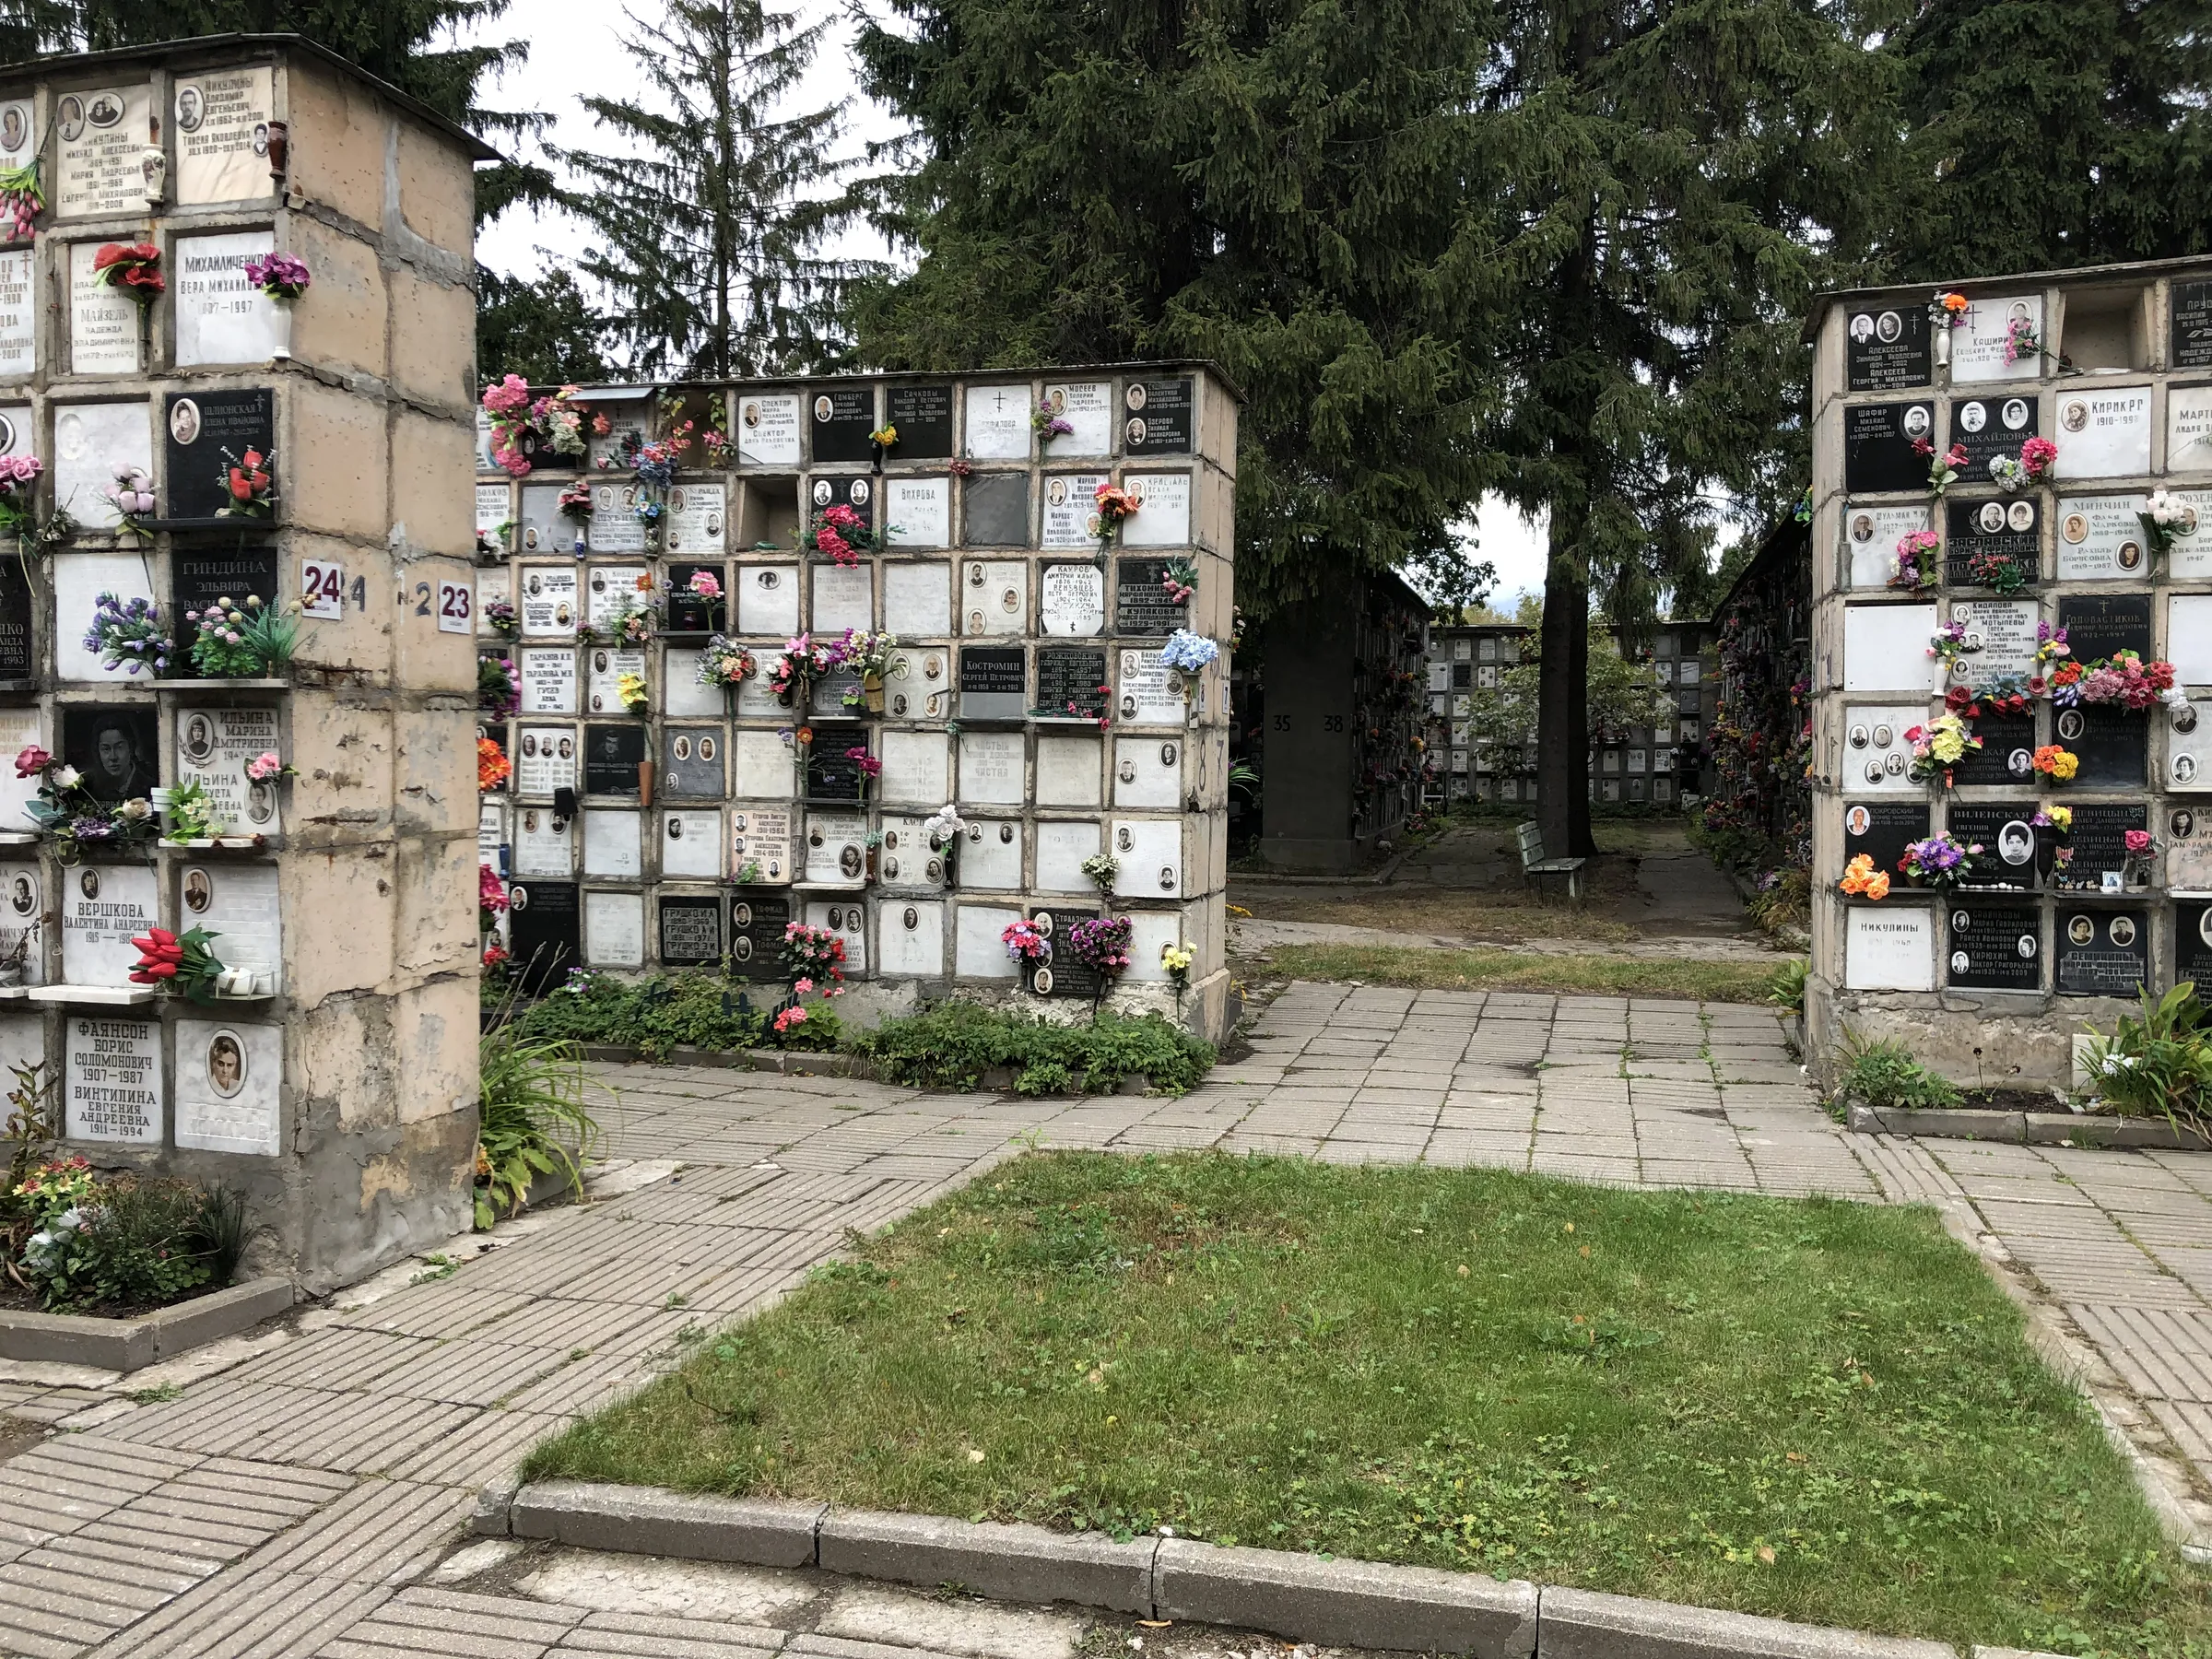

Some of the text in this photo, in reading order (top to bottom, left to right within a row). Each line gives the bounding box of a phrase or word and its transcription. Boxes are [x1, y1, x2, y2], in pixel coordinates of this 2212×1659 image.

[181, 280, 203, 294] ВЕРА
[81, 308, 128, 323] МАЙЗЕЛЬ
[1869, 345, 1908, 354] АЛЕКСЕЕВА
[1870, 368, 1906, 377] АЛЕКСЕЕВ
[1858, 409, 1888, 418] ШАФИР
[2176, 424, 2201, 433] ЛИДИЯ
[2074, 501, 2130, 511] МИНЧИН
[182, 560, 267, 575] ГИНДИНА
[196, 582, 252, 593] ЭЛЬВИРА
[304, 566, 339, 609] 24
[441, 586, 469, 618] 23
[968, 661, 1020, 671] КОСТРОМИН
[962, 672, 1024, 682] СЕРГЕЙ ПЕТРОВИЧ
[219, 712, 274, 724] ИЛЬИНА
[1274, 715, 1343, 733] 35 38
[225, 724, 273, 736] МАРИНА
[214, 736, 277, 748] ДМИТРИЕВНА
[184, 772, 238, 786] ИЛЬИНА
[77, 902, 144, 918] ВЕРШКОВА
[65, 916, 158, 931] ВАЛЕНТИНА АНДРЕЕВНА
[1861, 923, 1918, 933] НИКУЛИНЫ
[1971, 950, 2007, 959] КИРЮХИН
[78, 1022, 148, 1040] ФАЯНСОН
[94, 1040, 133, 1053] БОРИС
[75, 1053, 153, 1070] СОЛОМОНОВИЧ
[88, 1101, 141, 1114] ЕВГЕНИЯ
[79, 1112, 150, 1126] АНДРЕЕВНА
